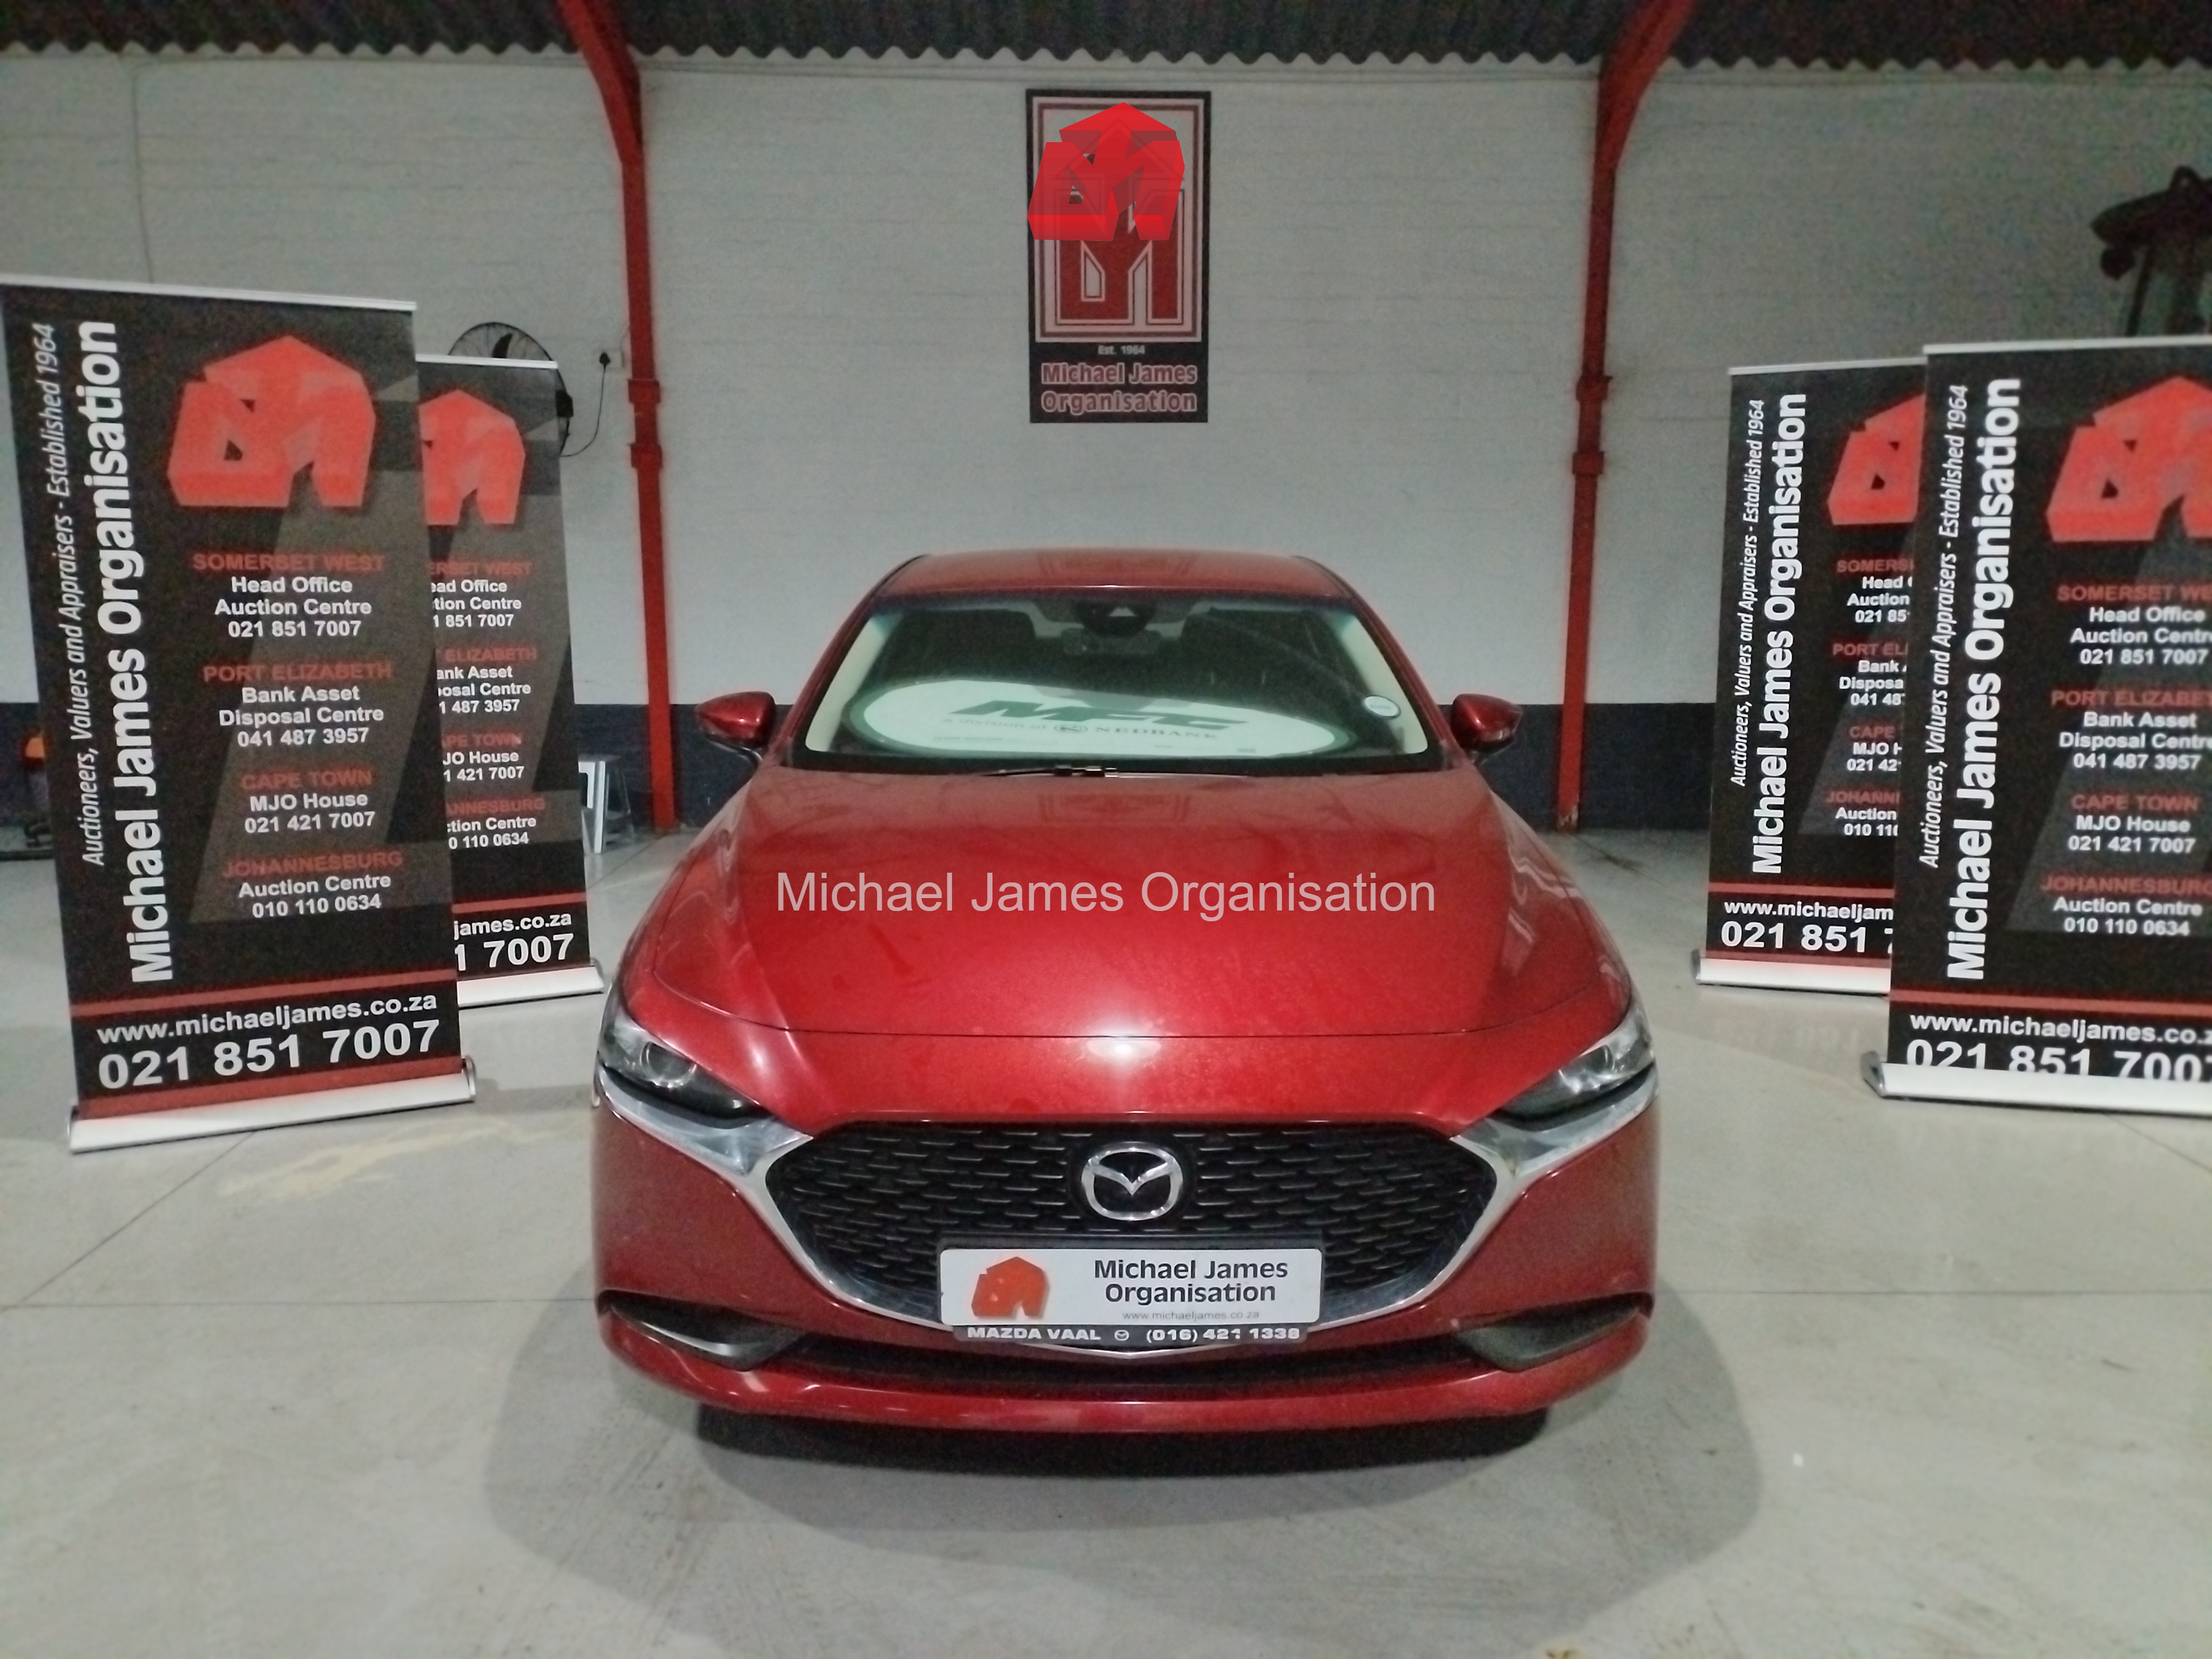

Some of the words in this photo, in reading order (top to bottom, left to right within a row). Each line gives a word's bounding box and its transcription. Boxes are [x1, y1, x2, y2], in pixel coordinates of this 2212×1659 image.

[33, 323, 56, 373] 1964
[1098, 345, 1117, 355] Est.
[1041, 362, 1125, 385] Michael
[1129, 362, 1198, 385] James
[1041, 390, 1197, 416] Organisation
[1947, 385, 1968, 429] 1964
[1748, 400, 1764, 436] 1964
[37, 380, 70, 497] Established
[76, 321, 145, 635] Organisation
[1743, 441, 1763, 522] Established
[1939, 434, 1965, 537] Established
[1764, 394, 1806, 621] Organisation
[1964, 379, 2020, 660] Organisation
[52, 514, 84, 621] Appraisers
[193, 553, 317, 570] SOMERSET
[326, 554, 385, 570] WEST
[1739, 536, 1758, 611] Appraisers
[1862, 576, 1903, 589] Head
[232, 577, 285, 592] Head
[292, 576, 353, 593] Office
[461, 579, 507, 592] Office
[2056, 584, 2174, 602] SOMERSET
[215, 599, 296, 615] Auction
[304, 599, 372, 615] Centre
[433, 596, 465, 610] tion
[470, 597, 522, 610] Centre
[1847, 593, 1910, 606] Auction
[1932, 552, 1957, 648] Appraisers
[446, 614, 471, 628] 851
[478, 614, 514, 627] 7007
[1855, 610, 1881, 623] 021
[2089, 606, 2140, 622] Head
[2146, 606, 2206, 622] Office
[228, 621, 264, 637] 021
[272, 621, 306, 637] 851
[314, 620, 361, 636] 7007
[1737, 612, 1753, 642] and
[2070, 628, 2147, 643] Auction
[2154, 628, 2212, 644] Centr
[60, 623, 85, 664] and
[1832, 643, 1880, 656] PORT
[1858, 659, 1899, 672] Bank
[1930, 649, 1950, 685] and
[2080, 649, 2113, 664] 021
[2120, 649, 2154, 664] 851
[2162, 649, 2209, 665] 7007
[203, 665, 266, 682] PORT
[272, 662, 391, 680] ELIZABETH
[468, 666, 512, 679] Asset
[1735, 644, 1753, 696] Valuers
[480, 683, 531, 696] Centre
[1758, 631, 1793, 738] James
[66, 668, 92, 740] Valuers
[242, 686, 295, 704] Bank
[301, 686, 360, 702] Asset
[1851, 693, 1877, 705] 041
[2052, 690, 2109, 706] PORT
[452, 700, 480, 713] 487
[484, 699, 520, 712] 3957
[108, 648, 157, 797] James
[219, 708, 310, 728] Disposal
[317, 706, 384, 723] Centre
[1925, 689, 1947, 754] Valuers
[2083, 711, 2134, 727] Bank
[2139, 711, 2197, 727] Asset
[238, 731, 272, 747] 041
[281, 730, 315, 745] 487
[323, 727, 369, 744] 3957
[1096, 727, 1217, 738] NEDBANK
[1849, 726, 1894, 738] CAPE
[1956, 673, 2001, 809] James
[2059, 732, 2145, 751] Disposal
[1731, 700, 1751, 786] Auctioneers,
[1853, 742, 1889, 755] MJO
[469, 751, 519, 764] House
[1846, 759, 1873, 771] 021
[2073, 753, 2106, 768] 041
[2113, 753, 2149, 768] 487
[2155, 753, 2201, 770] 3957
[241, 773, 301, 789] CAPE
[311, 770, 372, 786] TOWN
[457, 768, 483, 781] 421
[489, 766, 524, 780] 7007
[77, 747, 105, 866] Auctioneers,
[249, 794, 297, 811] MJO
[303, 793, 368, 809] House
[1752, 746, 1787, 873] Michael
[2072, 794, 2128, 810] CAPE
[2135, 795, 2198, 811] TOWN
[245, 817, 279, 833] 021
[287, 814, 321, 831] 421
[329, 812, 375, 828] 7007
[486, 817, 536, 830] Centre
[1835, 807, 1897, 820] Auction
[1919, 760, 1948, 868] Auctioneers,
[1844, 823, 1872, 836] 010
[2076, 815, 2121, 831] MJO
[2126, 816, 2191, 833] House
[463, 835, 488, 848] 110
[493, 832, 529, 846] 0634
[2068, 835, 2101, 851] 021
[2107, 836, 2141, 852] 421
[2149, 837, 2196, 853] 7007
[222, 851, 403, 878] JOHANNESBURG
[238, 880, 318, 898] Auction
[325, 874, 391, 891] Centre
[115, 810, 173, 983] Michael
[253, 901, 288, 918] 010
[295, 898, 328, 914] 110
[335, 894, 381, 912] 0634
[1947, 819, 1992, 980] Michael
[2053, 896, 2129, 913] Auction
[2136, 899, 2203, 916] Centre
[453, 913, 572, 941] james.co.za
[2064, 917, 2098, 933] 010
[2105, 918, 2137, 934] 110
[2143, 920, 2190, 936] 0634
[1721, 921, 1784, 948] 021
[1801, 924, 1866, 953] 851
[483, 933, 574, 968] 7007
[97, 995, 436, 1043] www.michaeljames.co.za
[99, 1047, 189, 1089] 021
[214, 1035, 300, 1076] 851
[323, 1020, 440, 1062] 7007
[1906, 1038, 1987, 1070] 021
[2114, 1050, 2212, 1082] 700
[1094, 1259, 1197, 1279] Michael
[1204, 1260, 1289, 1278] James
[1104, 1283, 1276, 1306] Organisation
[968, 1327, 1042, 1339] MAZDA
[1047, 1328, 1101, 1340] VAAL
[1146, 1329, 1198, 1343] (016)
